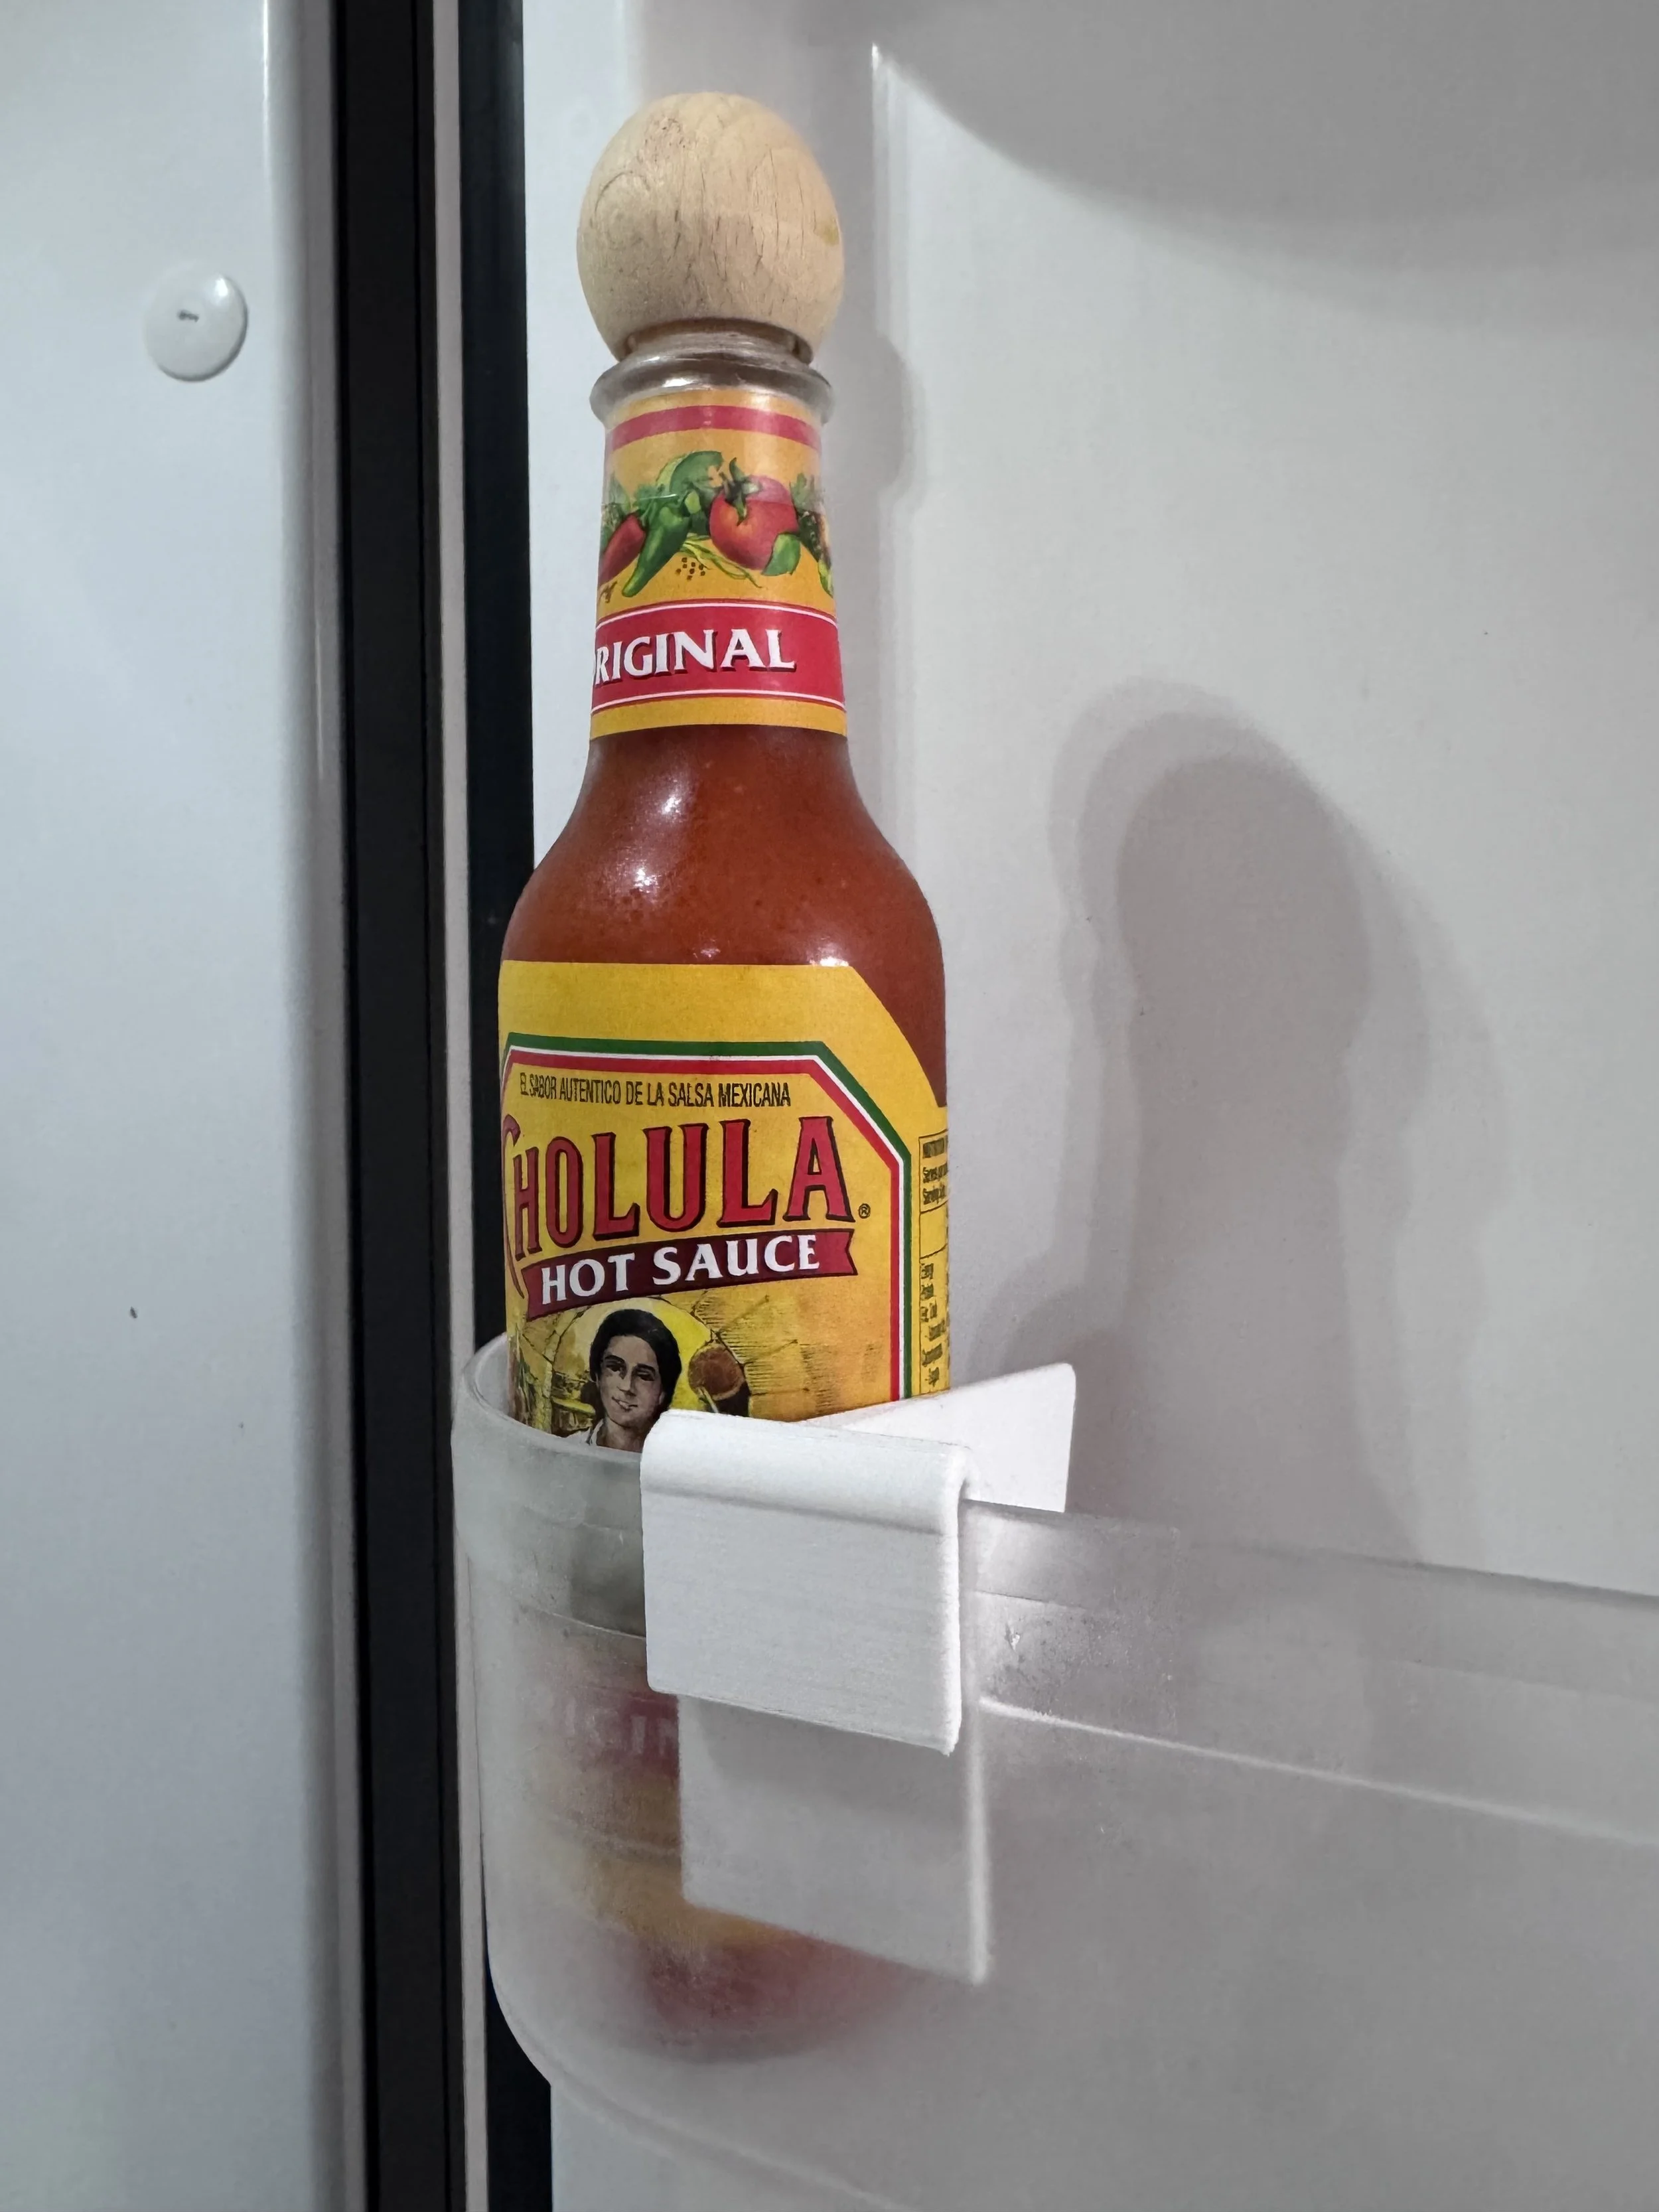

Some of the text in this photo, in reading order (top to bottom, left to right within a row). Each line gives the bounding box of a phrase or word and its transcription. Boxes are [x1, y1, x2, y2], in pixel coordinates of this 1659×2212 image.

[593, 628, 796, 688] RIGINAL
[530, 1074, 557, 1100] SABOR
[559, 1077, 621, 1105] AUTENTICO
[626, 1081, 642, 1105] DE
[647, 1083, 664, 1107] LA
[668, 1082, 714, 1107] SALSA
[719, 1082, 791, 1108] MEXICANA
[501, 1114, 856, 1298] CHOLULA
[541, 1234, 820, 1305] HOT SAUCE
